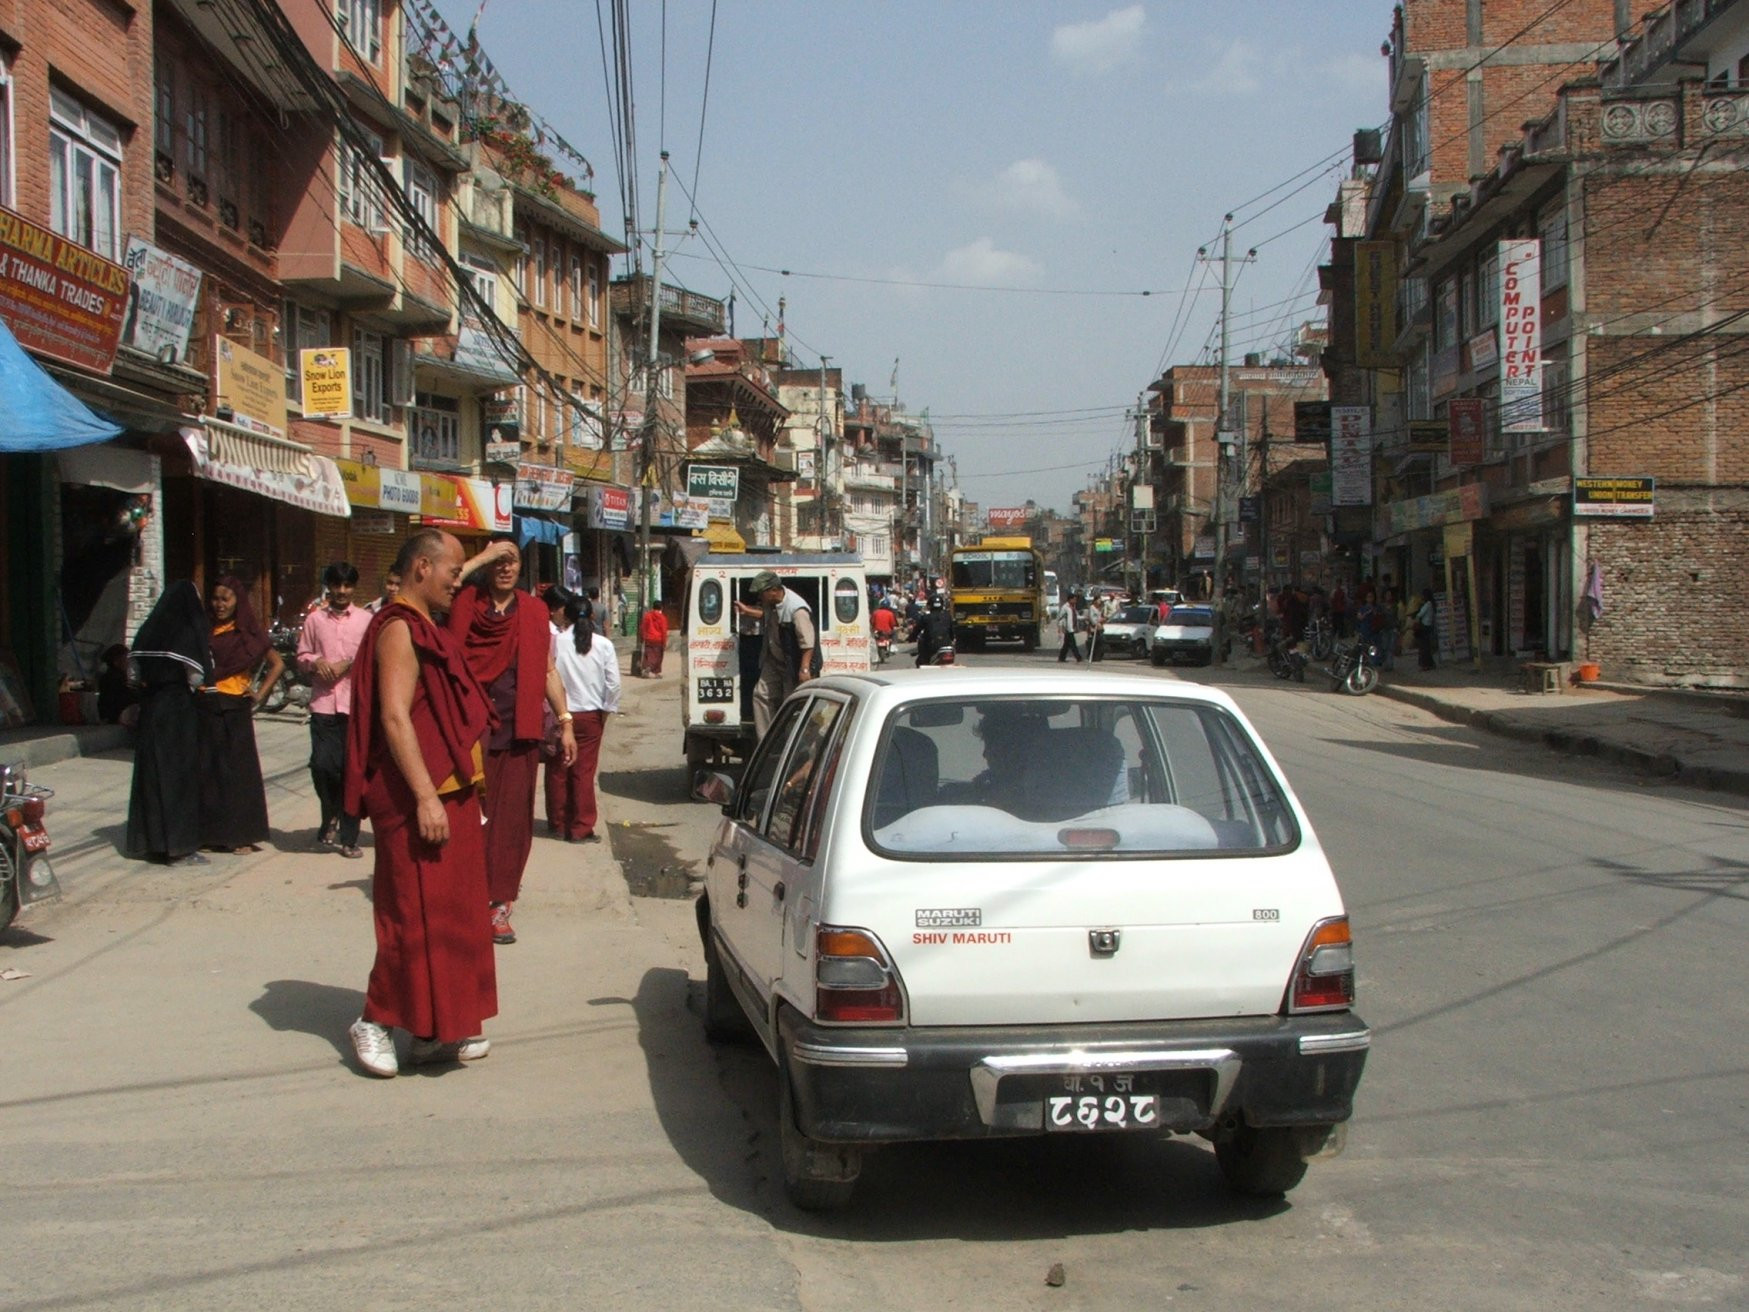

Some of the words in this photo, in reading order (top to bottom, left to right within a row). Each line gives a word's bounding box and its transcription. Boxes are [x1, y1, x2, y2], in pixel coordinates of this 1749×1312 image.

[56, 240, 127, 296] ARTICLES
[0, 252, 9, 277] &
[11, 257, 57, 295] THANKA
[60, 279, 105, 315] TRADES
[1503, 262, 1521, 378] COMPUTER
[1521, 305, 1536, 378] POINT
[305, 370, 326, 381] Snow
[328, 369, 345, 380] Lion
[1505, 377, 1537, 386] NEPAL
[312, 382, 342, 394] Exports
[690, 472, 707, 485] बस
[1588, 490, 1613, 499] UNION
[699, 688, 732, 698] 3632
[916, 909, 981, 918] MARUTI
[1254, 909, 1279, 920] 800
[916, 918, 981, 927] SUZUKI
[912, 932, 948, 945] SHIV
[952, 932, 1012, 944] MARUTI
